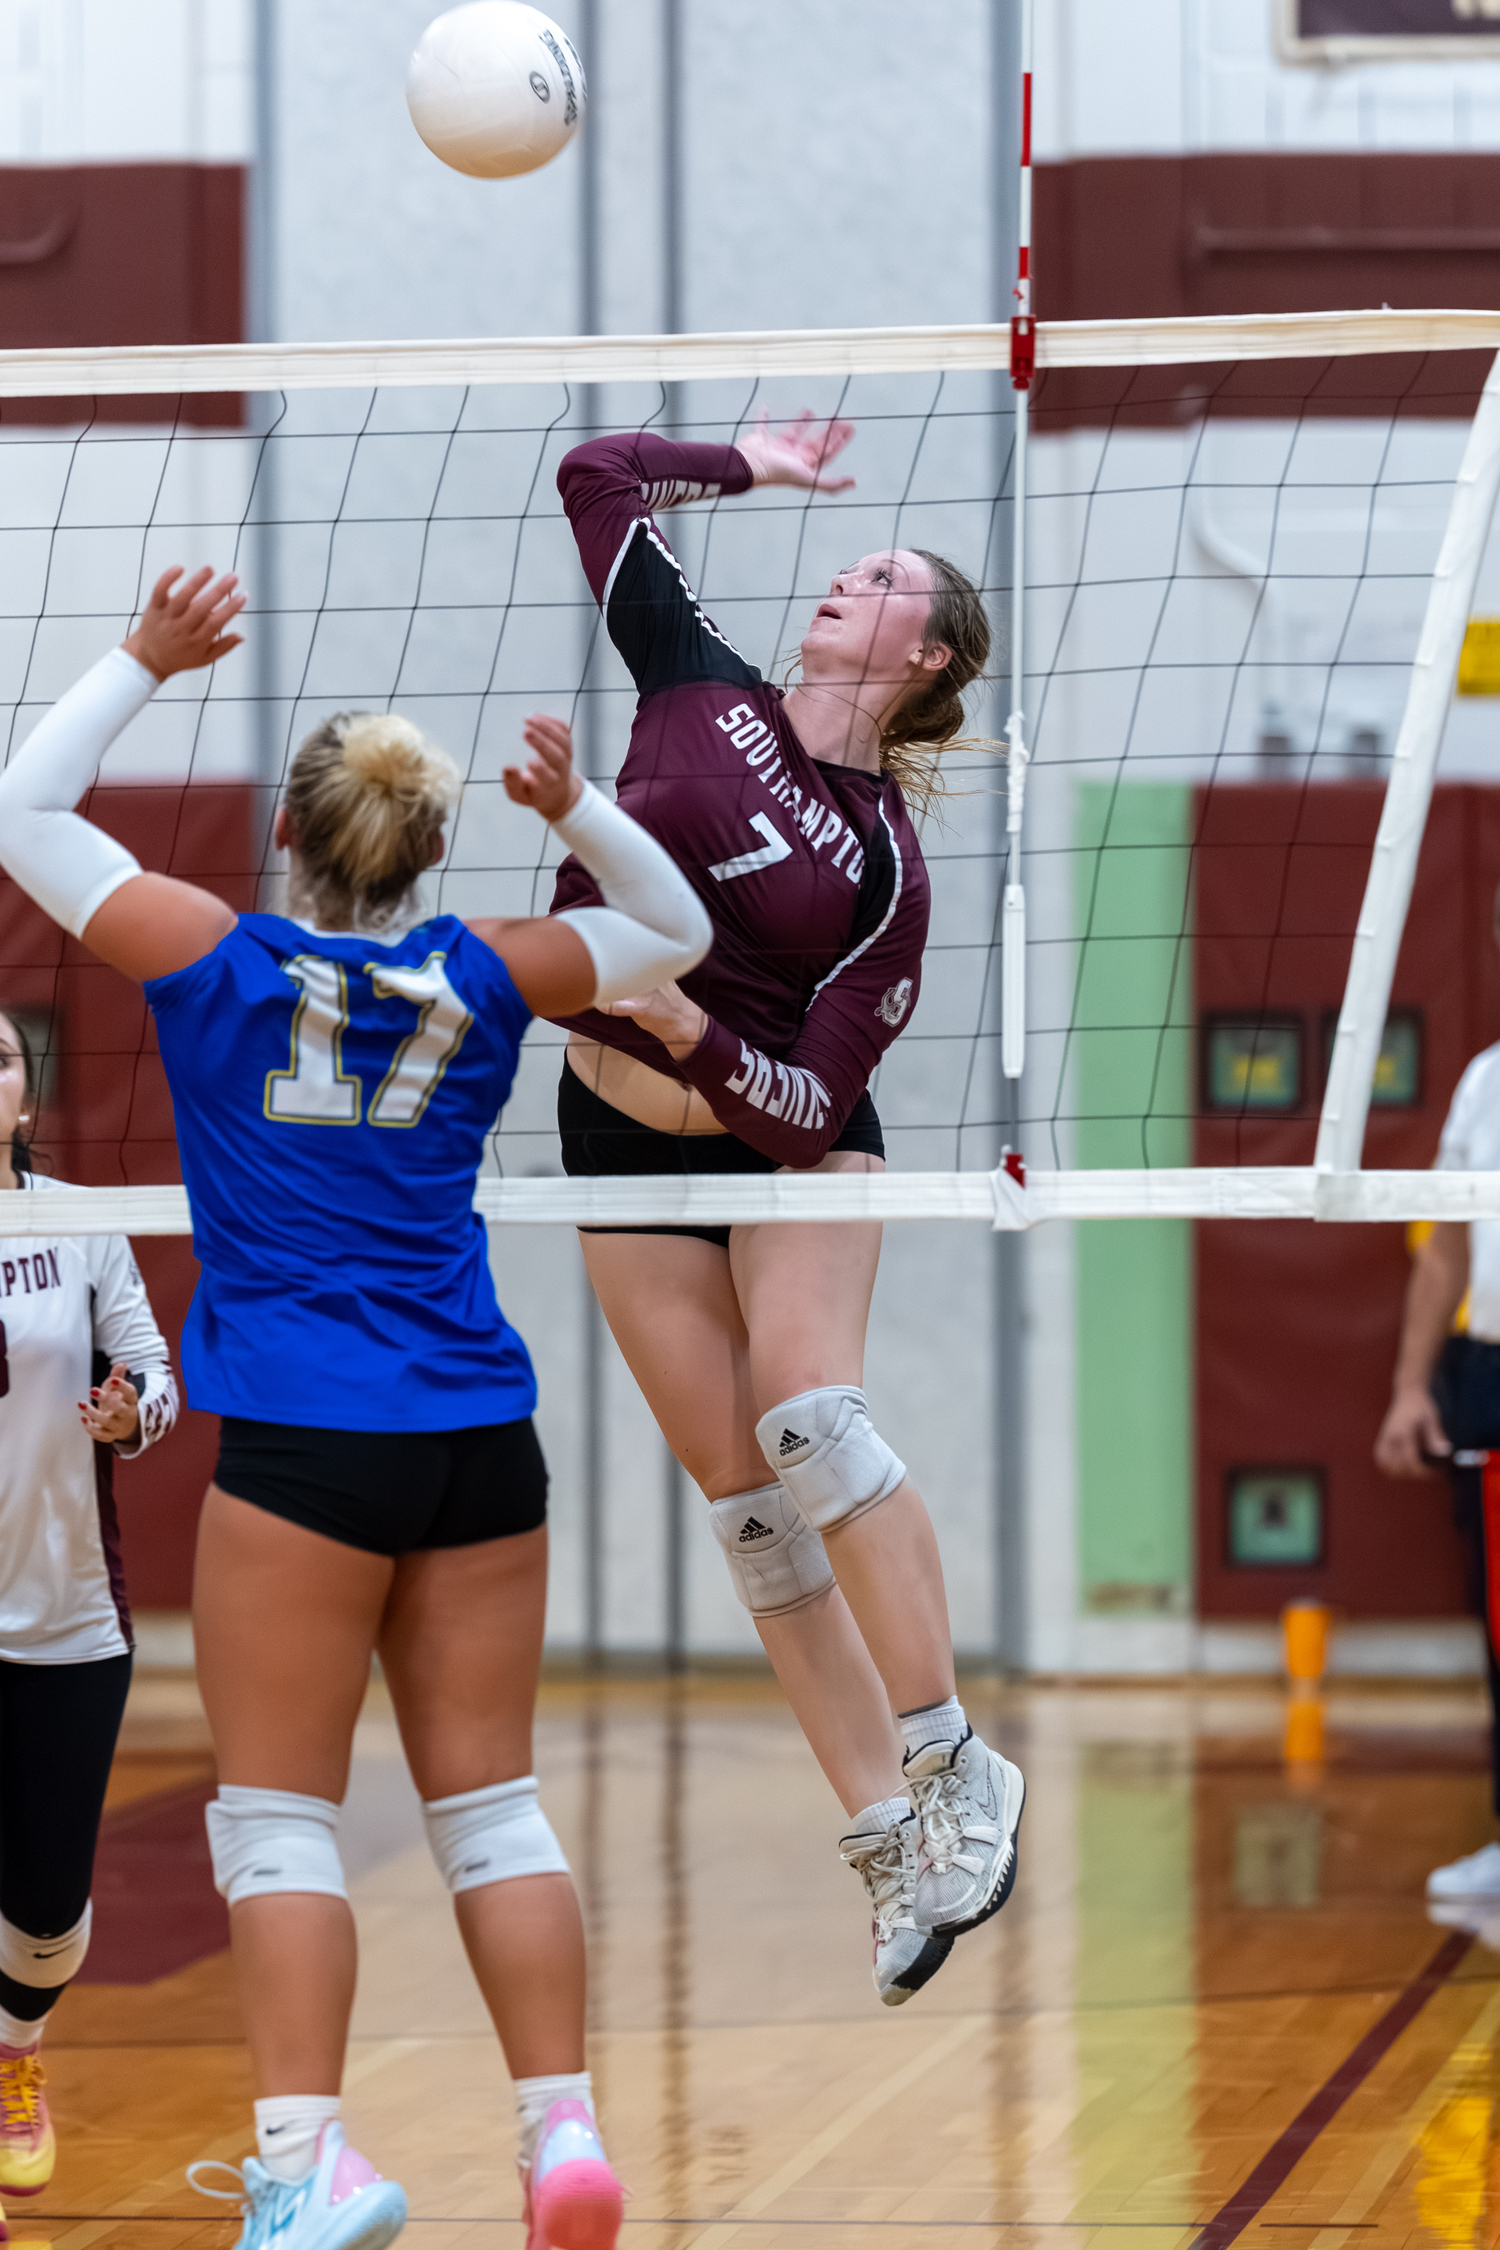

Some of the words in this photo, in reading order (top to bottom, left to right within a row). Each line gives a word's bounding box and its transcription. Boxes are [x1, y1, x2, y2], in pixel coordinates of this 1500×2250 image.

[715, 702, 866, 889] SOUTHAMPTO
[708, 811, 793, 882] 7
[263, 950, 474, 1128] 17
[0, 1246, 61, 1298] PTON
[779, 1436, 810, 1457] adidas
[738, 1526, 774, 1543] adidas
